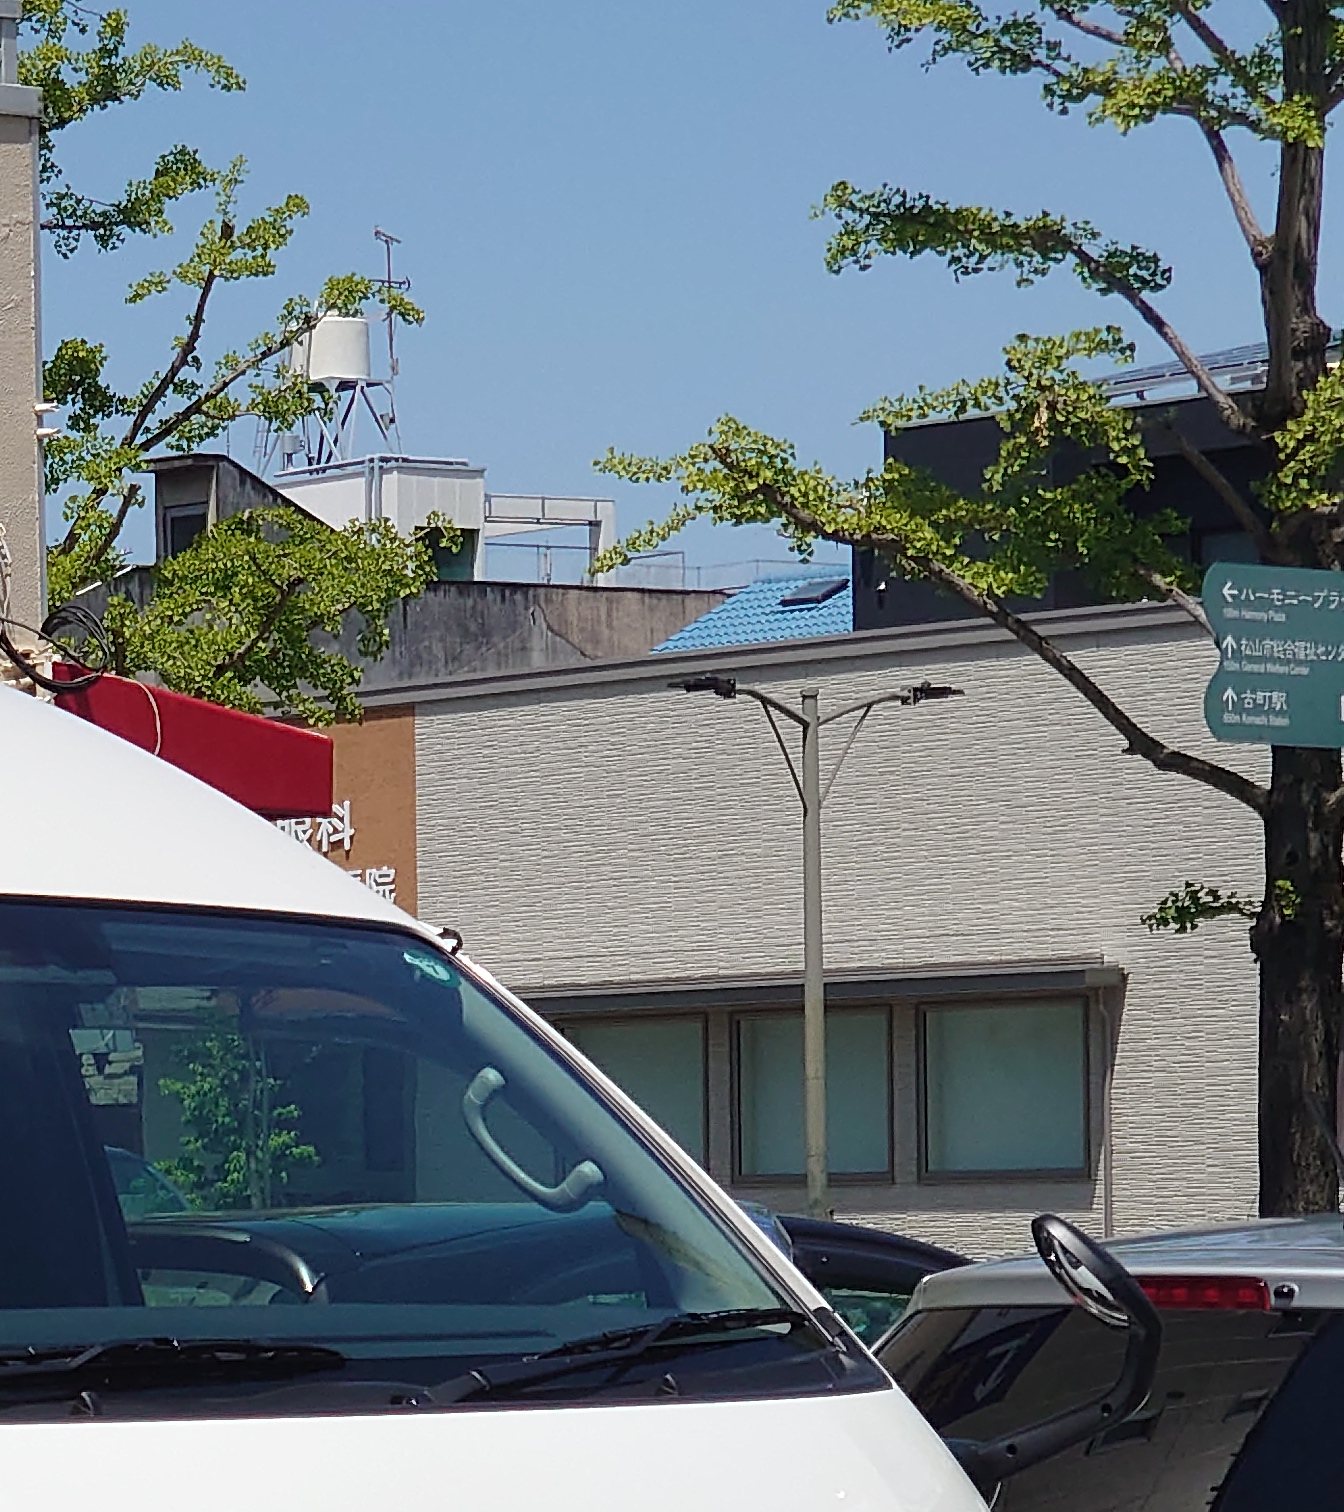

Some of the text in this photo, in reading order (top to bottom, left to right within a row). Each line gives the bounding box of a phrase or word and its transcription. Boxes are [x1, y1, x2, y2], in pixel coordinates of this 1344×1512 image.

[1241, 689, 1287, 711] 古町駅
[348, 866, 396, 904] 院
